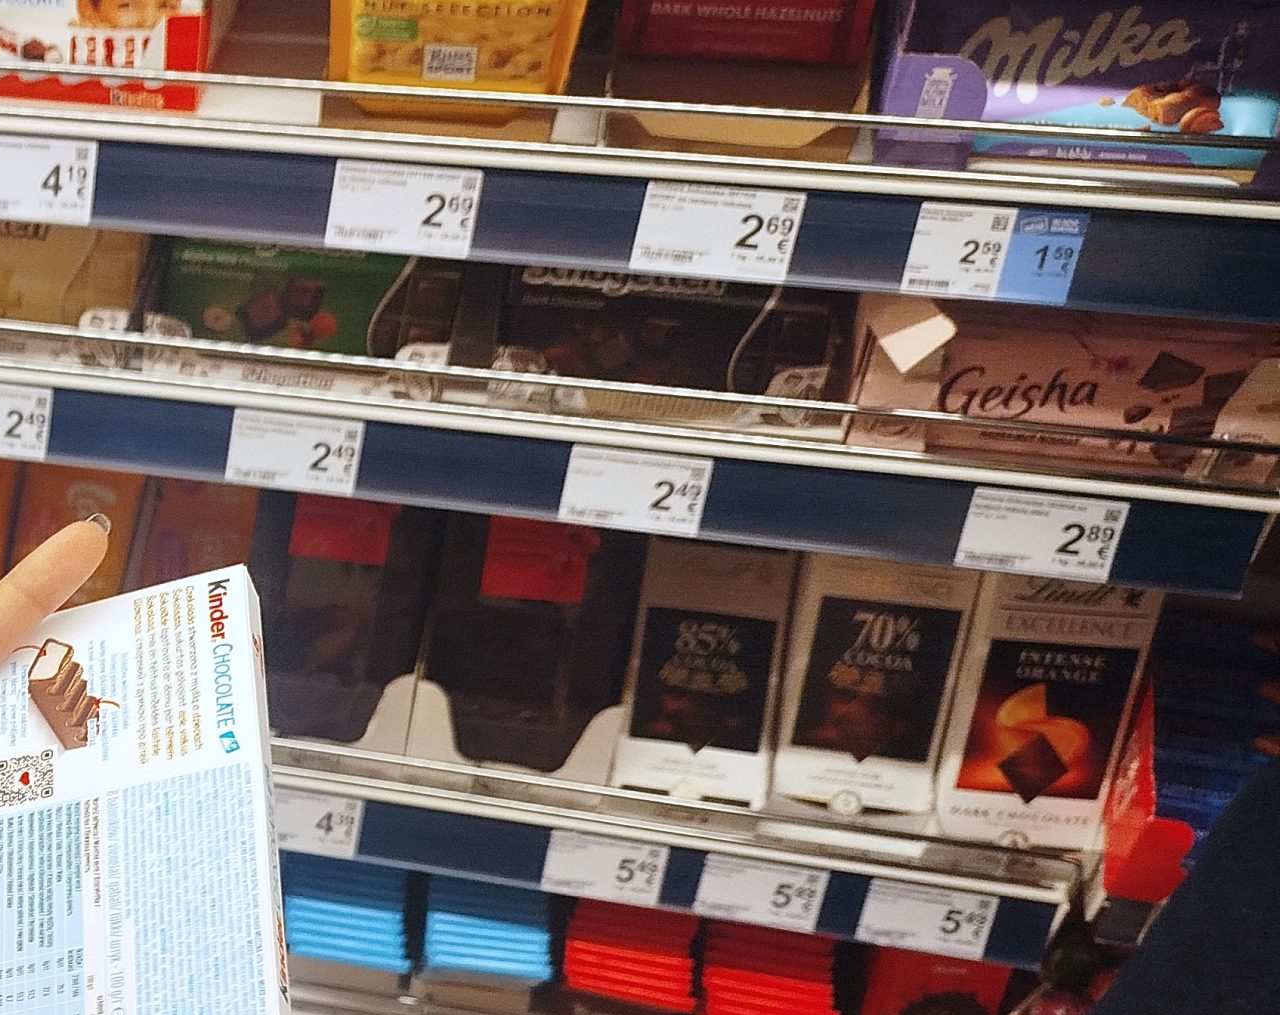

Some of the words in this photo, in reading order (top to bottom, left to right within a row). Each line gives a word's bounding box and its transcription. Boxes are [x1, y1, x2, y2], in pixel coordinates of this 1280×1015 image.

[960, 6, 1200, 103] Milka
[939, 366, 1100, 419] Geisha
[852, 610, 921, 652] 70%
[212, 643, 234, 729] CHOCOLATE
[110, 971, 124, 989] 100
